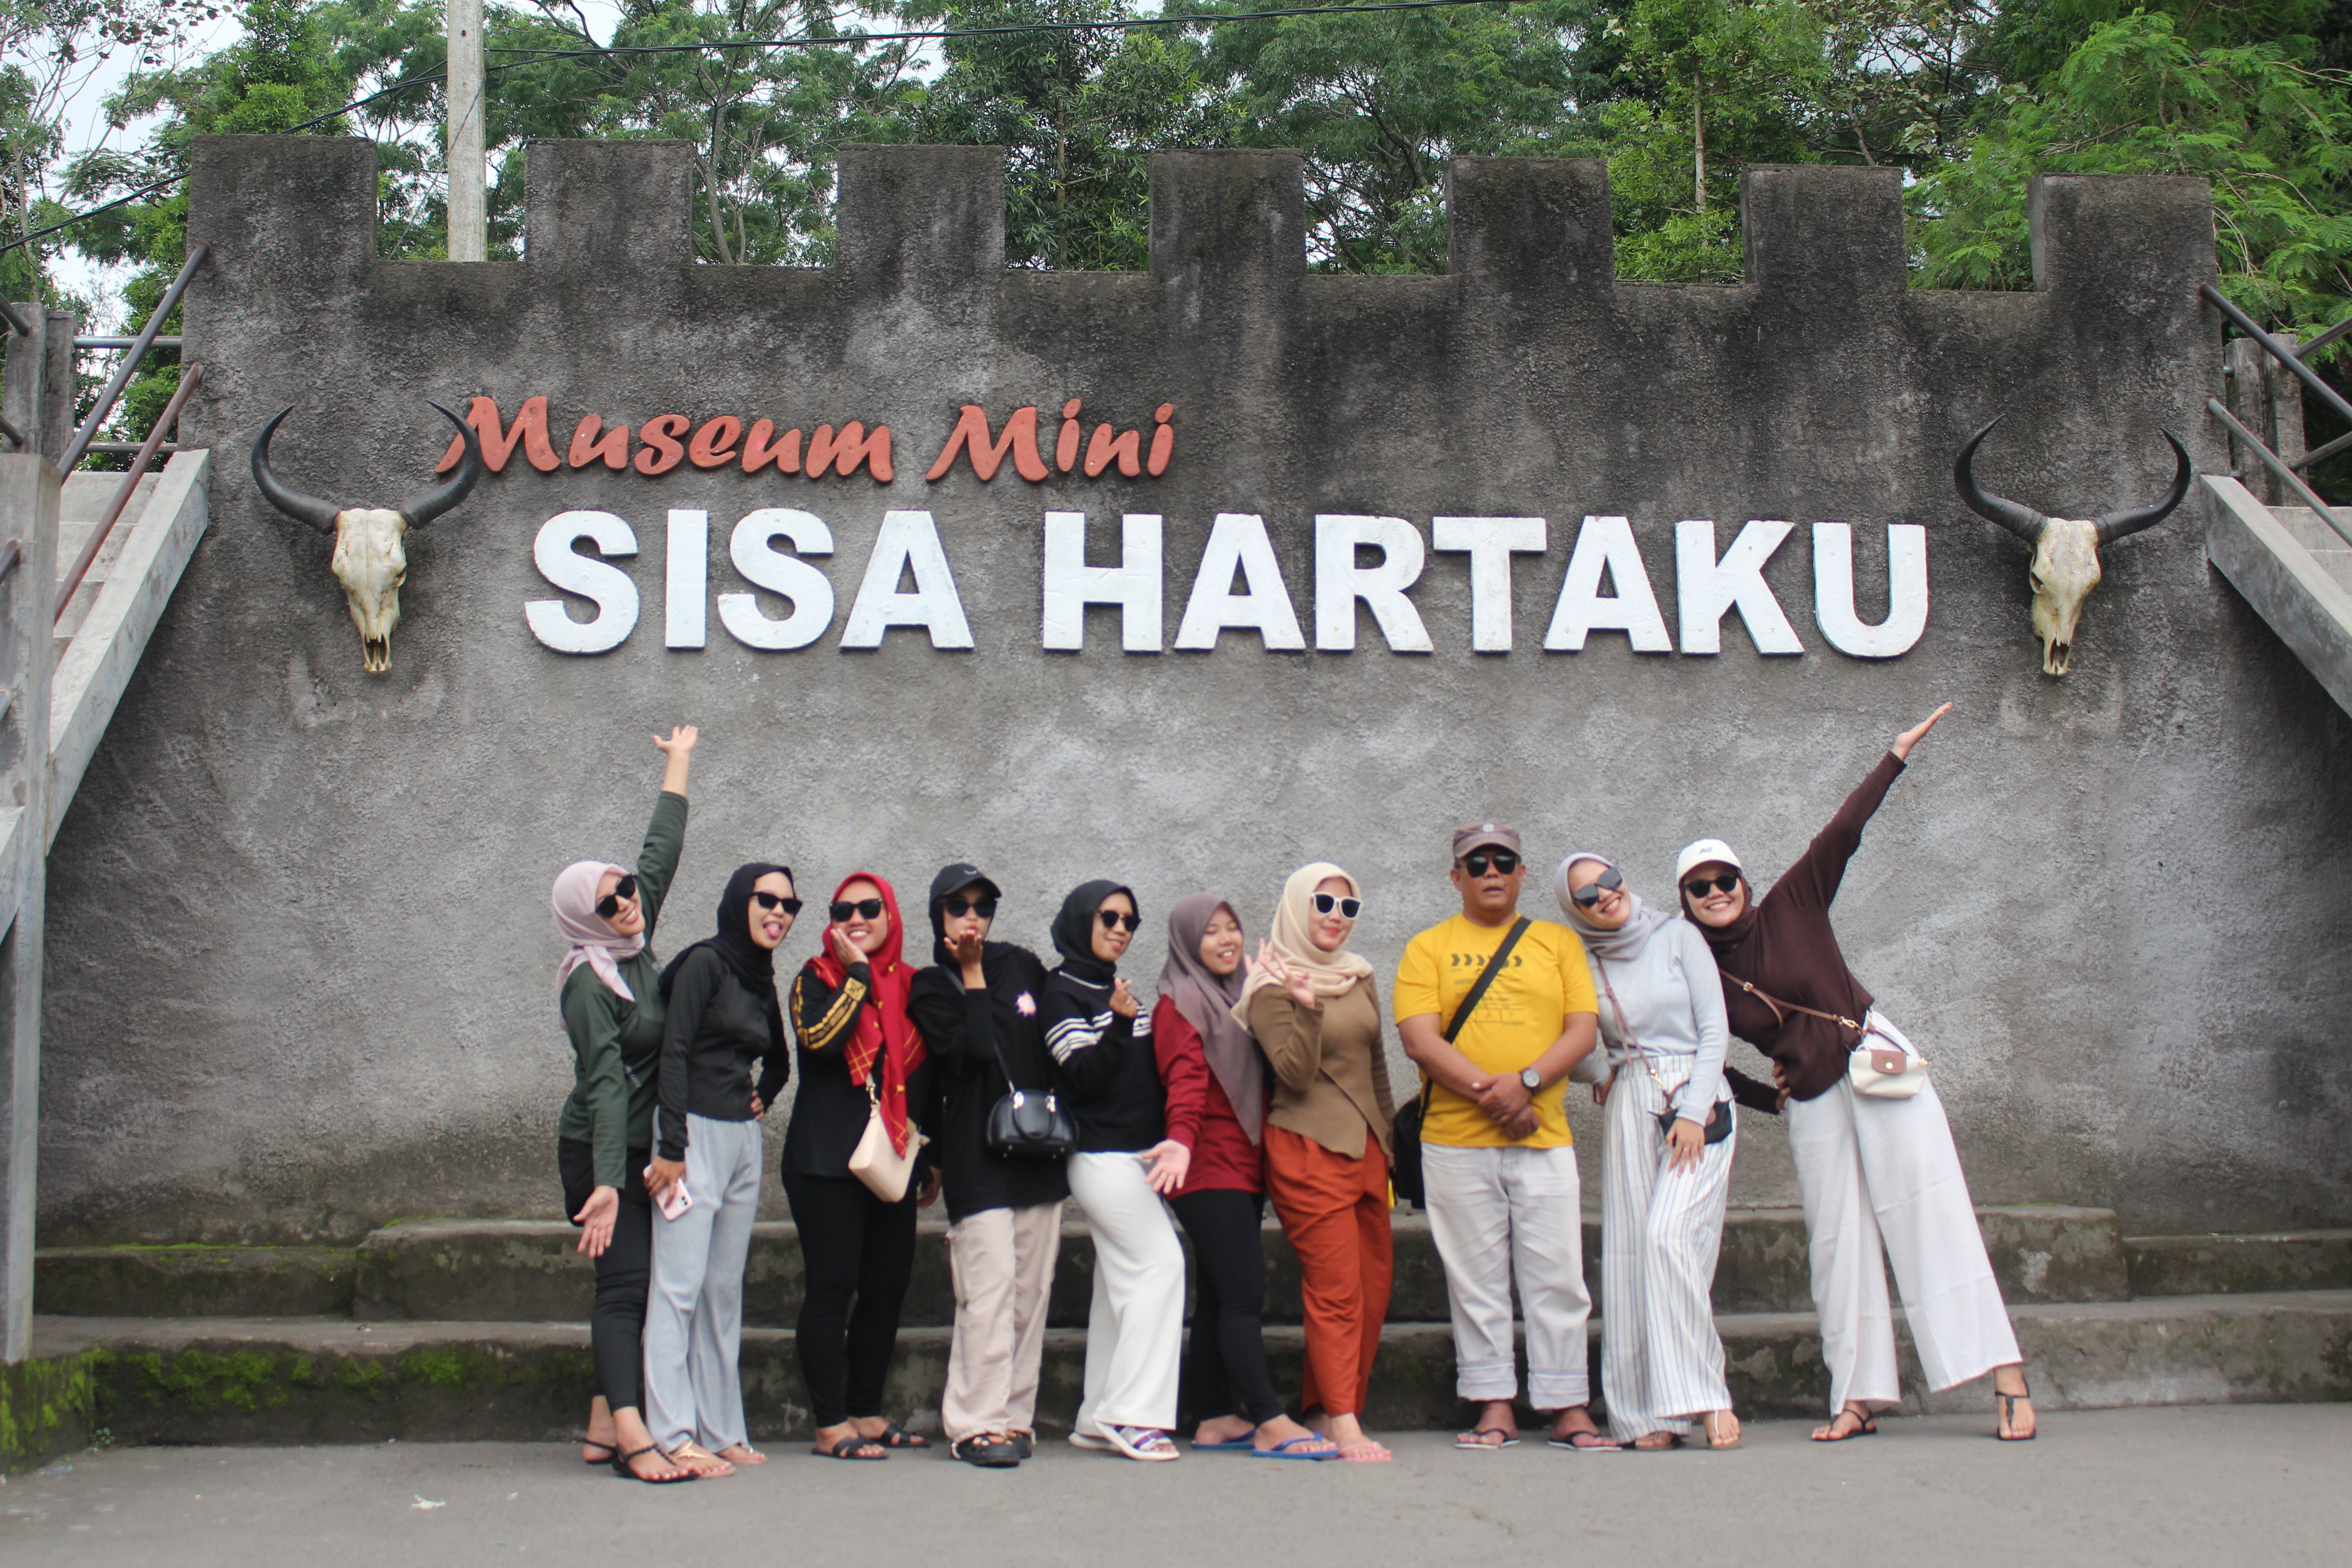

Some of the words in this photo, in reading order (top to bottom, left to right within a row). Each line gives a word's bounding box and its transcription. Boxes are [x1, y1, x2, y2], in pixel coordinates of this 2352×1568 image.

[435, 396, 894, 481] Museum
[925, 398, 1174, 481] Mini
[524, 508, 975, 652] SISA
[1042, 511, 1928, 657] HARTAKU
